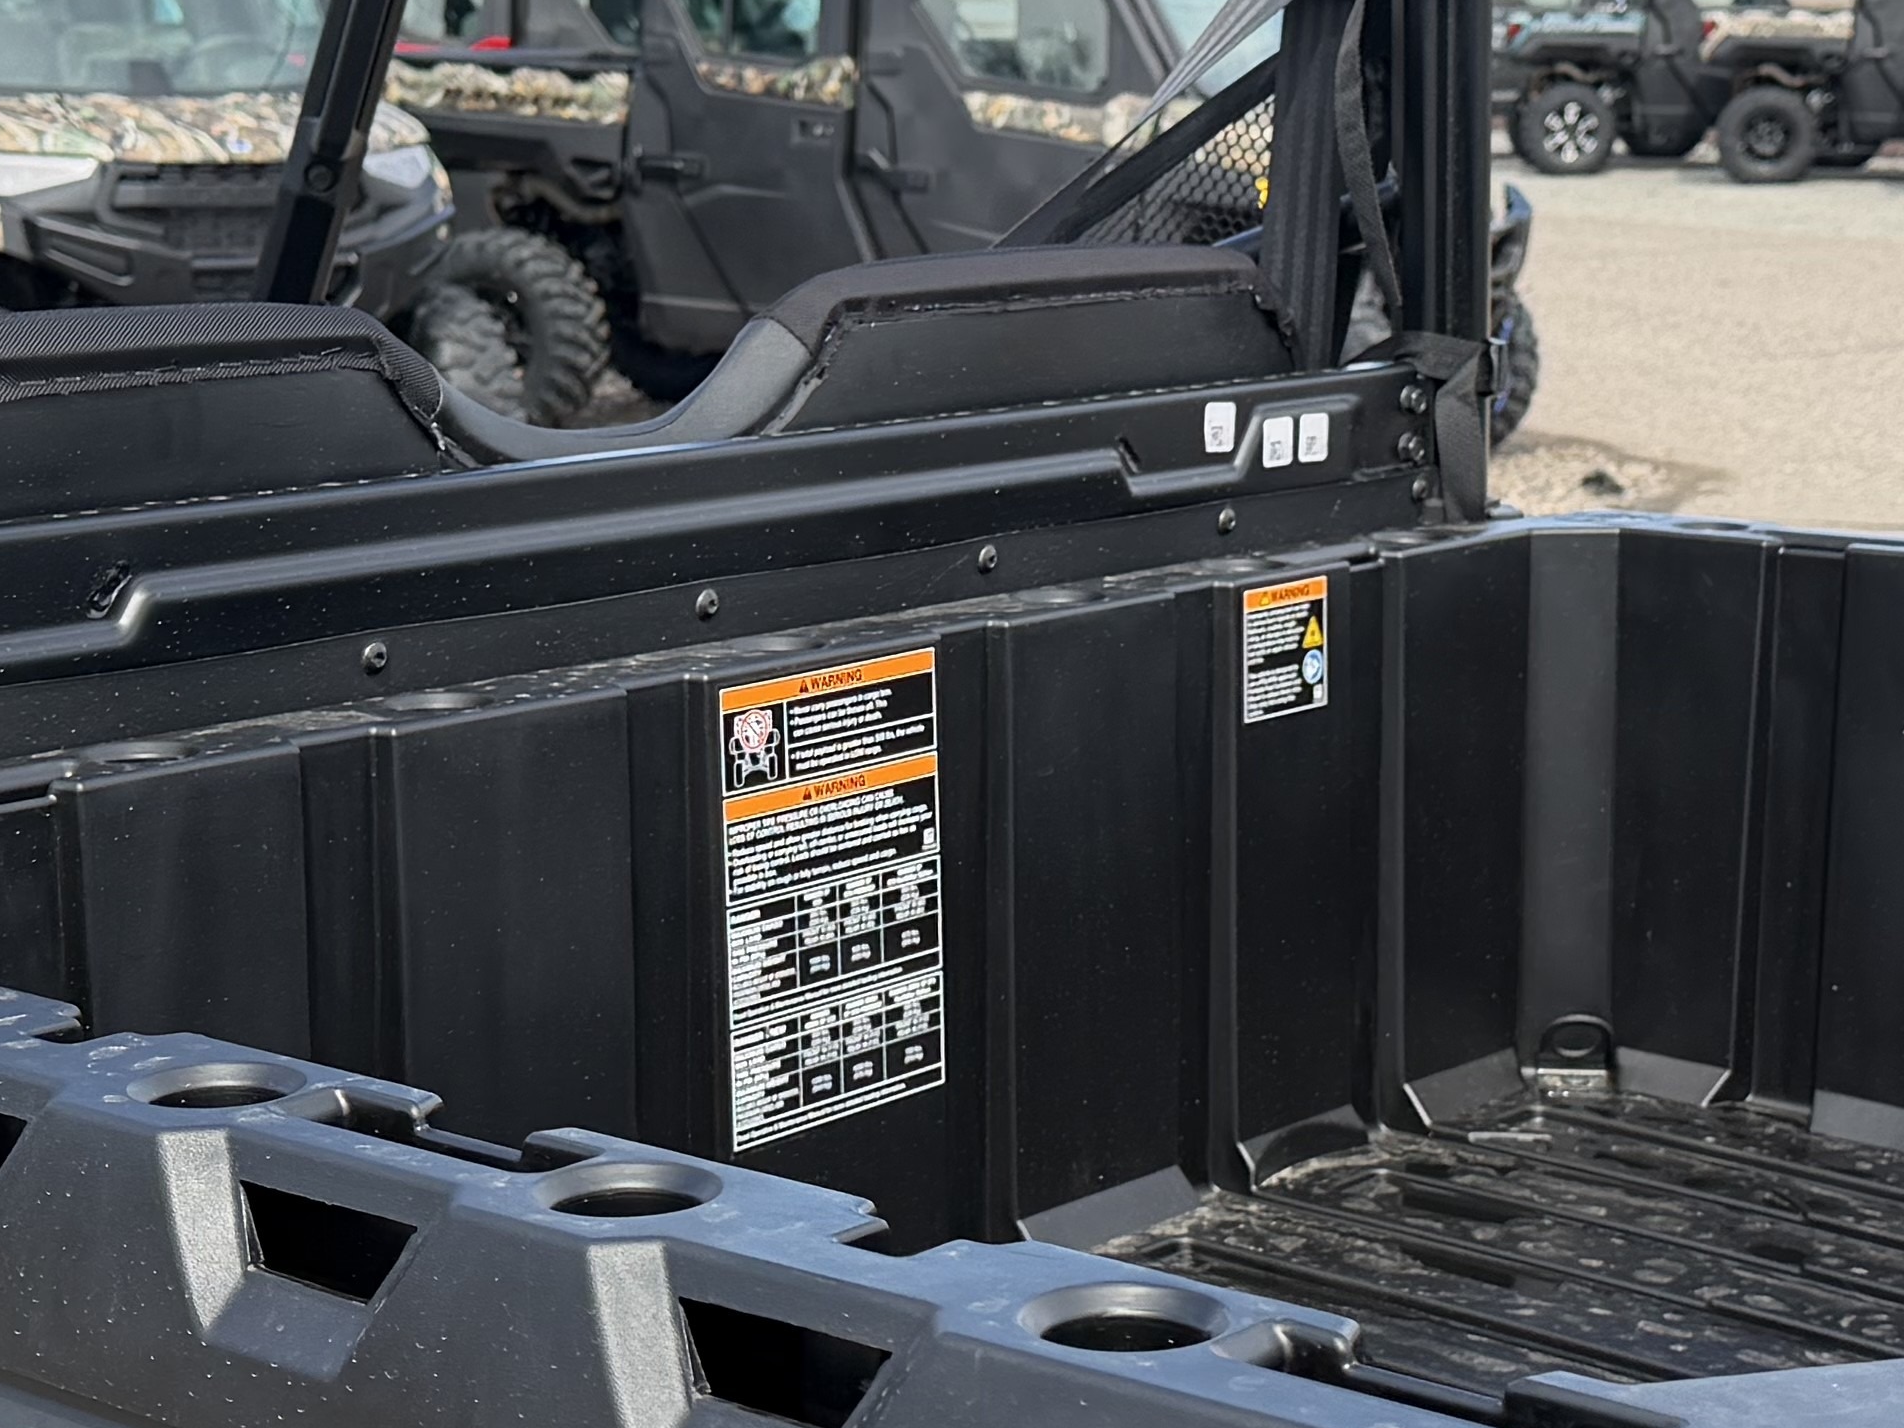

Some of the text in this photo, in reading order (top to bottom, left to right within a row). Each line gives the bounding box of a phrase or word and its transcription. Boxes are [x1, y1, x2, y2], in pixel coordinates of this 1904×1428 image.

[1271, 584, 1310, 602] WARNING
[810, 669, 862, 690] WARNING
[813, 774, 866, 797] WARNING
